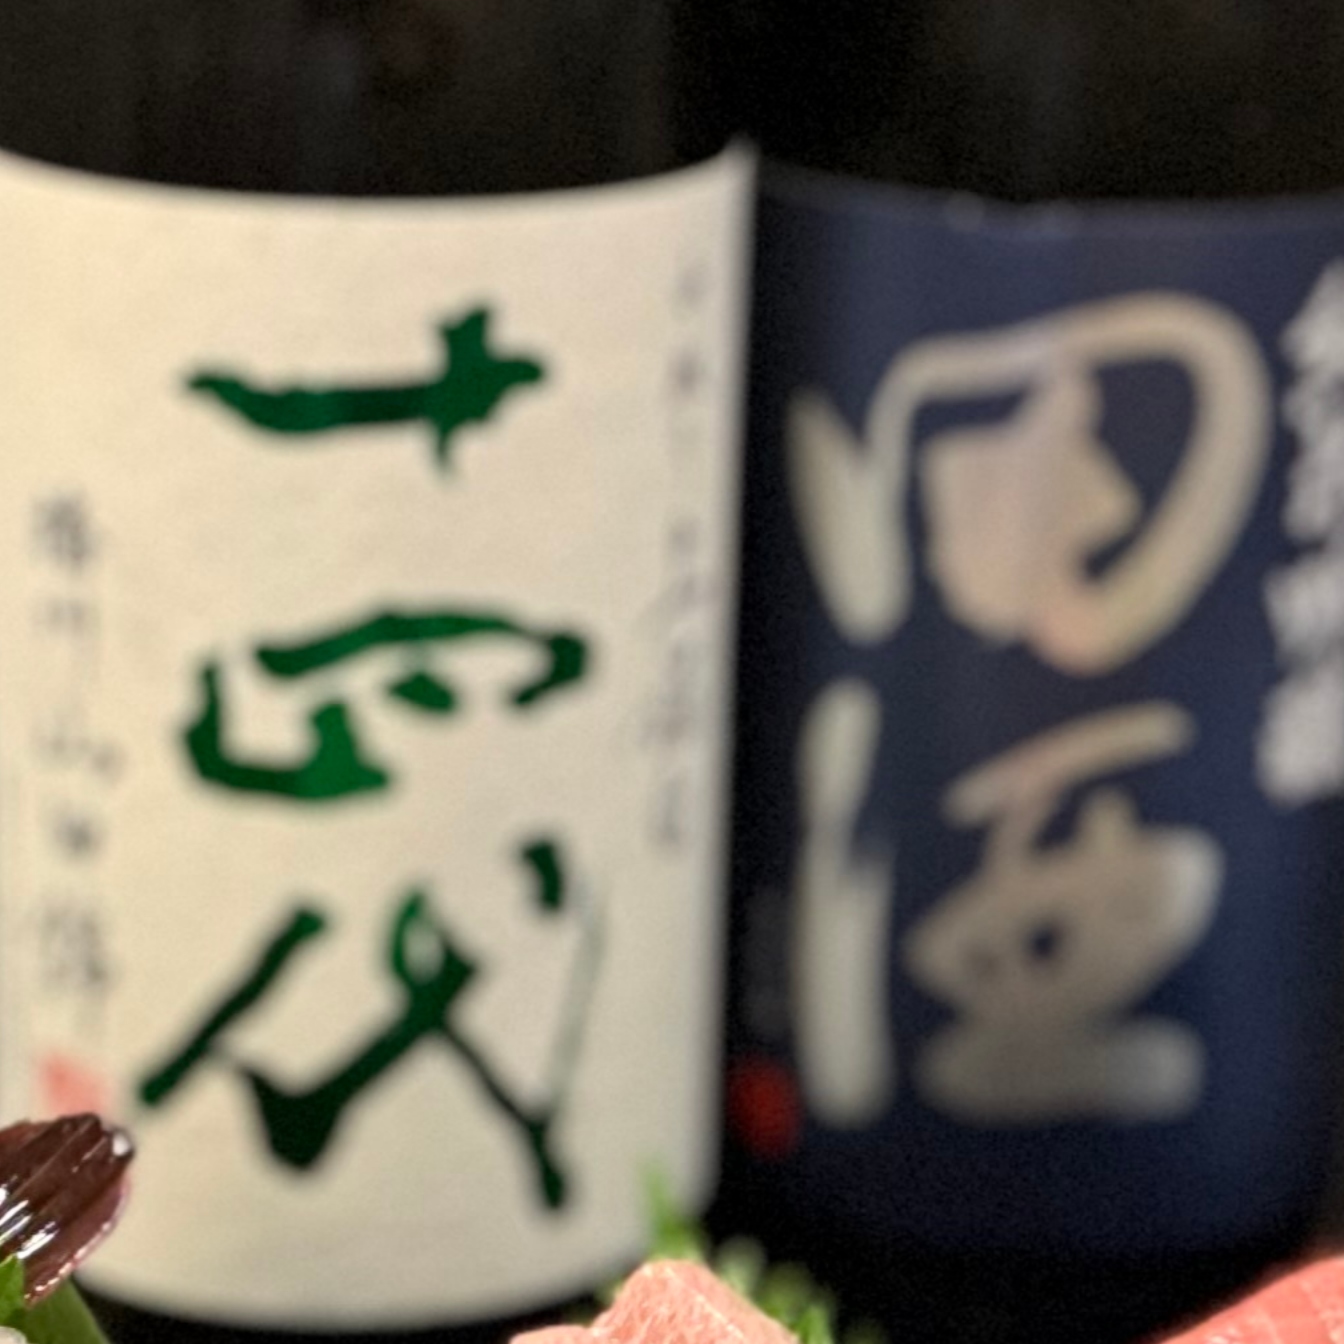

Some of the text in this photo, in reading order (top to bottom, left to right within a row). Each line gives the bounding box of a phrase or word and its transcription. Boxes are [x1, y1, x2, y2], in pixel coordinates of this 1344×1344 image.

[140, 301, 596, 1212] 十四代
[790, 288, 1272, 1124] 田酒
